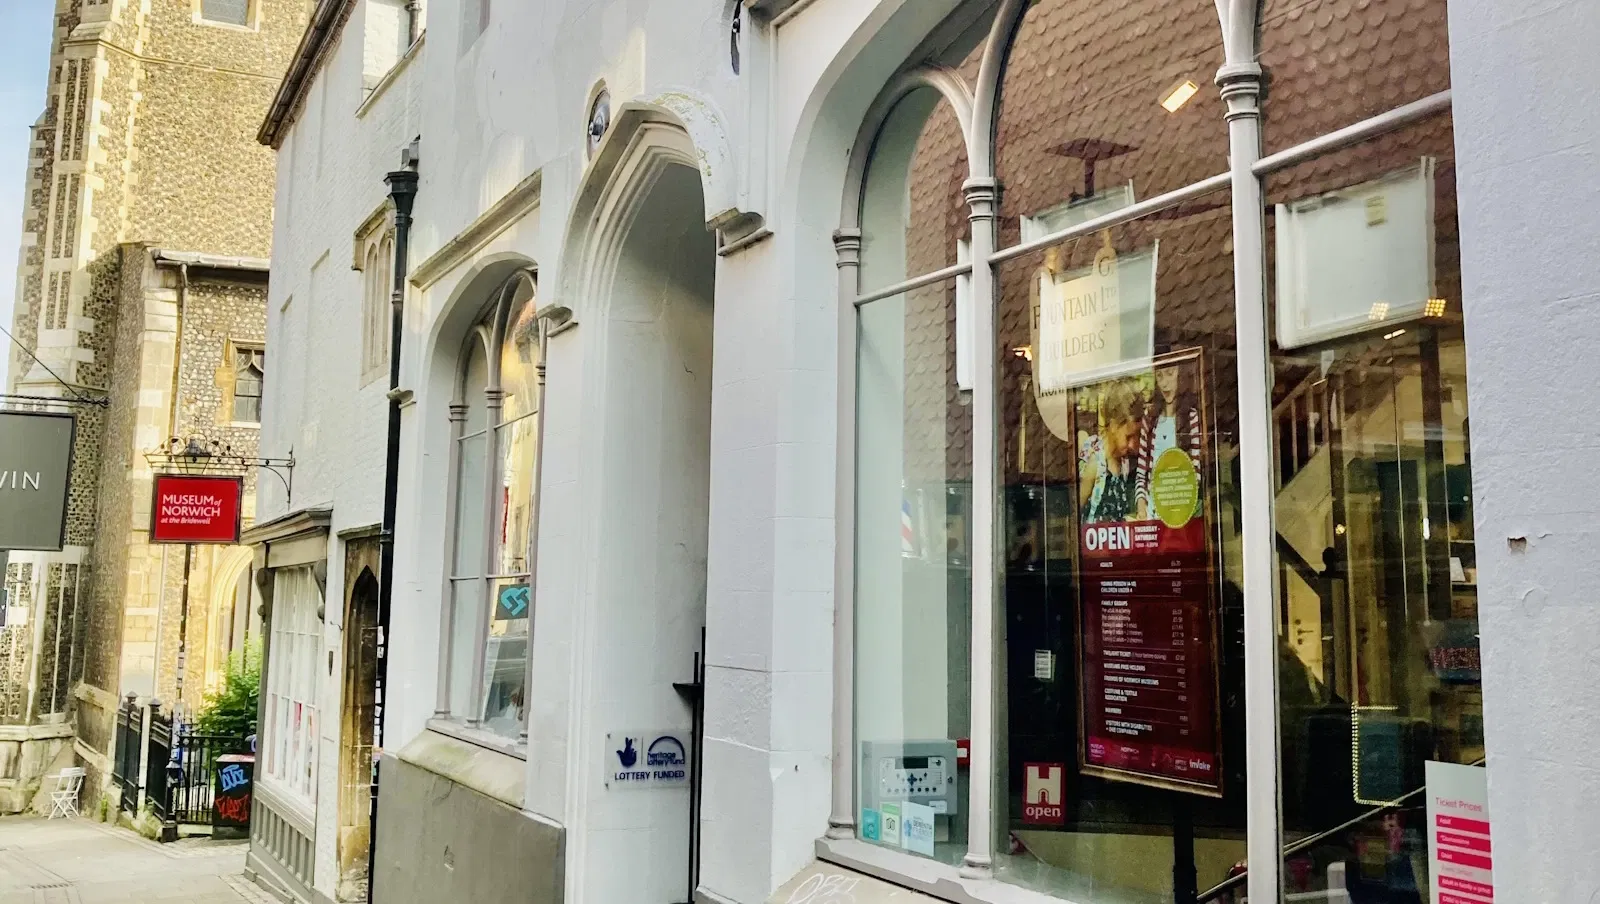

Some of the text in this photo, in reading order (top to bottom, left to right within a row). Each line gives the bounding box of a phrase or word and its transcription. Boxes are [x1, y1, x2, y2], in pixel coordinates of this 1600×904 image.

[162, 494, 223, 507] MUSEUM of
[161, 506, 221, 517] NORWICH
[1085, 526, 1130, 551] OPEN
[647, 751, 676, 761] heritage
[614, 770, 685, 781] LOTTERY FUNDED
[1436, 796, 1483, 812] Ticket Prices
[1025, 806, 1061, 820] open
